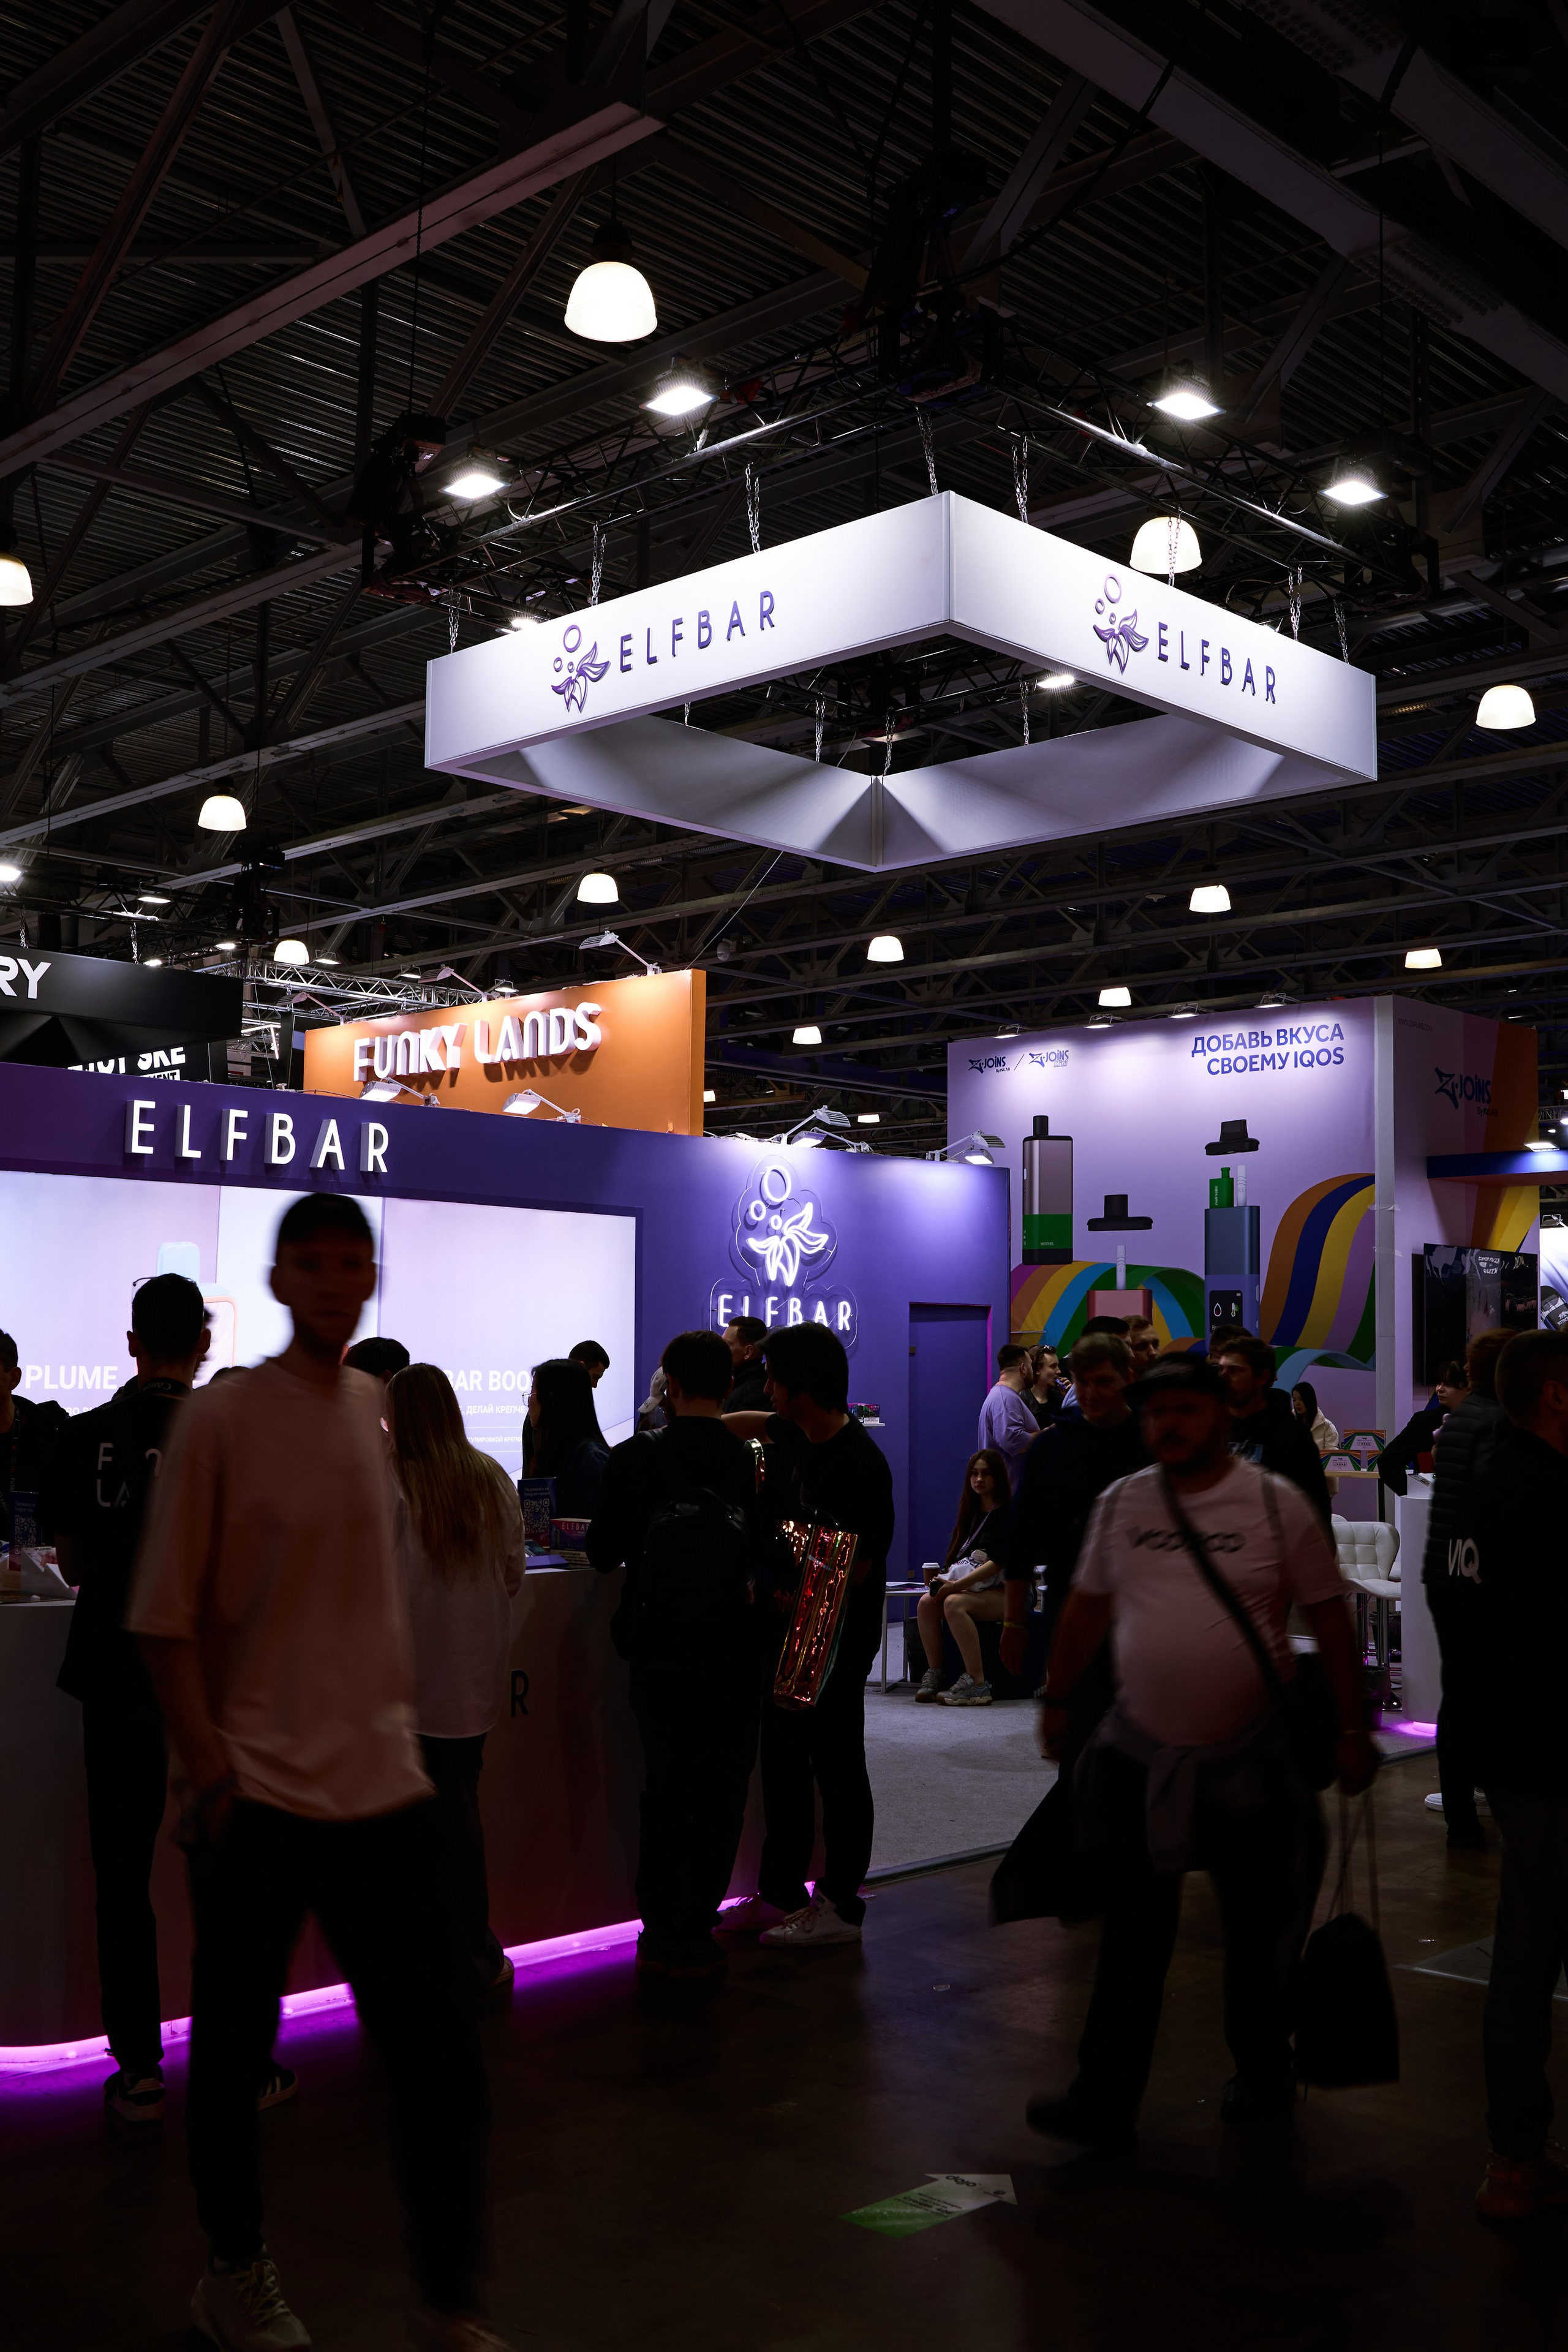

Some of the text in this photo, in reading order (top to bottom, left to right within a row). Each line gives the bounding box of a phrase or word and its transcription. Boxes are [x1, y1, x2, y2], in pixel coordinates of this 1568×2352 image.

[620, 590, 775, 673] ELFBAR
[1158, 621, 1276, 704] ELFBAR
[353, 1001, 603, 1082] FUNKY LANDS
[1191, 1023, 1344, 1058] ДОБАВЬ ВКУСА
[1207, 1047, 1344, 1076] СВОЕМУ IQOS
[125, 1100, 389, 1173] ELFBAR
[24, 1365, 119, 1390] PLUME
[466, 1404, 494, 1415] ДЕЛАЙ
[496, 1405, 526, 1414] КРЕПЧЕ
[945, 2175, 977, 2187] dojo
